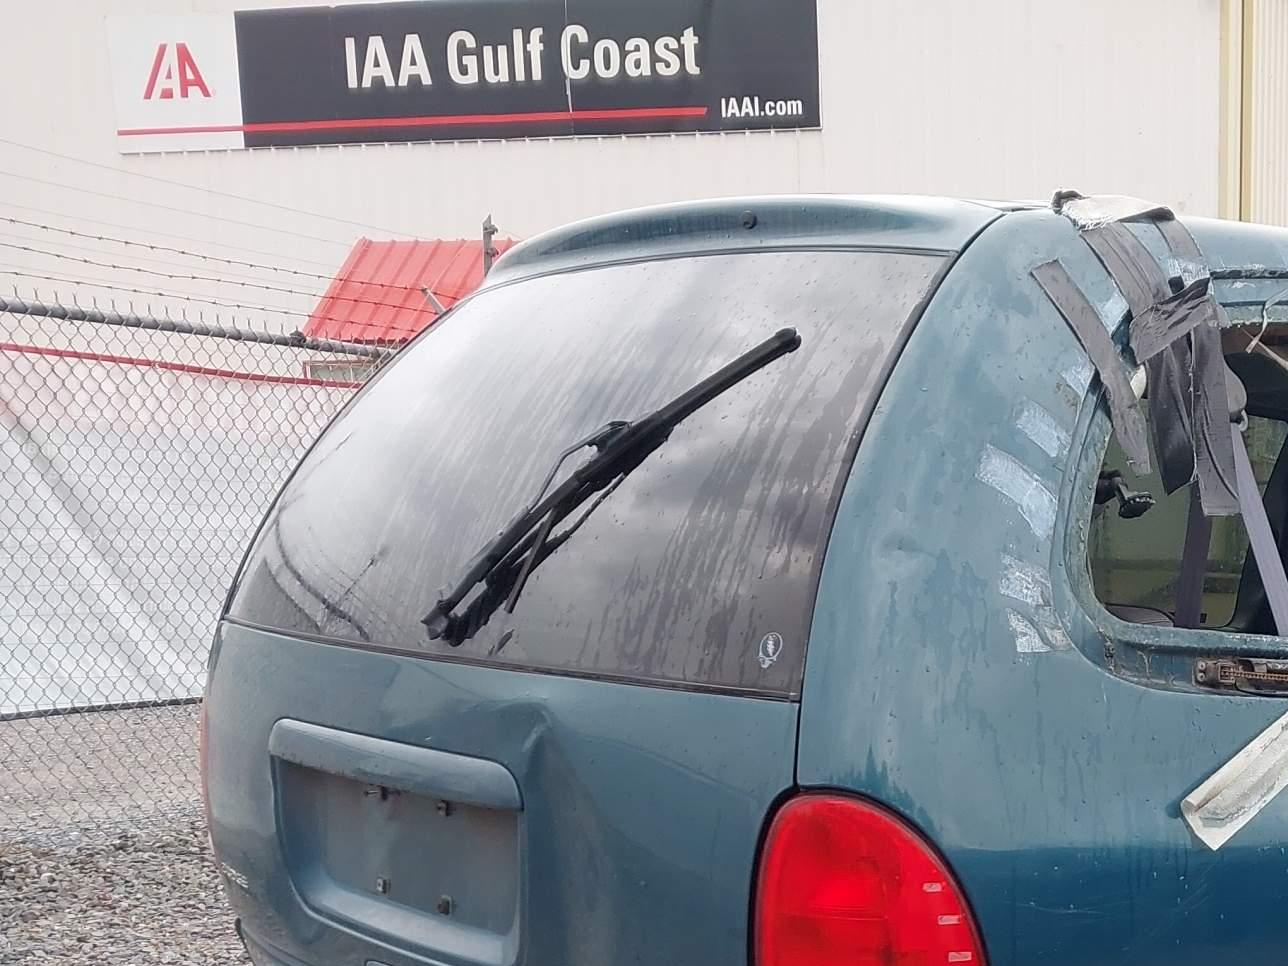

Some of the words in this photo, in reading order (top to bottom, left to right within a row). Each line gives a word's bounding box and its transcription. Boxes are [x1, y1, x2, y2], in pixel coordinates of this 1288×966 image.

[343, 33, 433, 89] IAA
[446, 25, 544, 84] Gulf
[561, 25, 702, 80] Coast
[719, 95, 803, 119] IAAI.com
